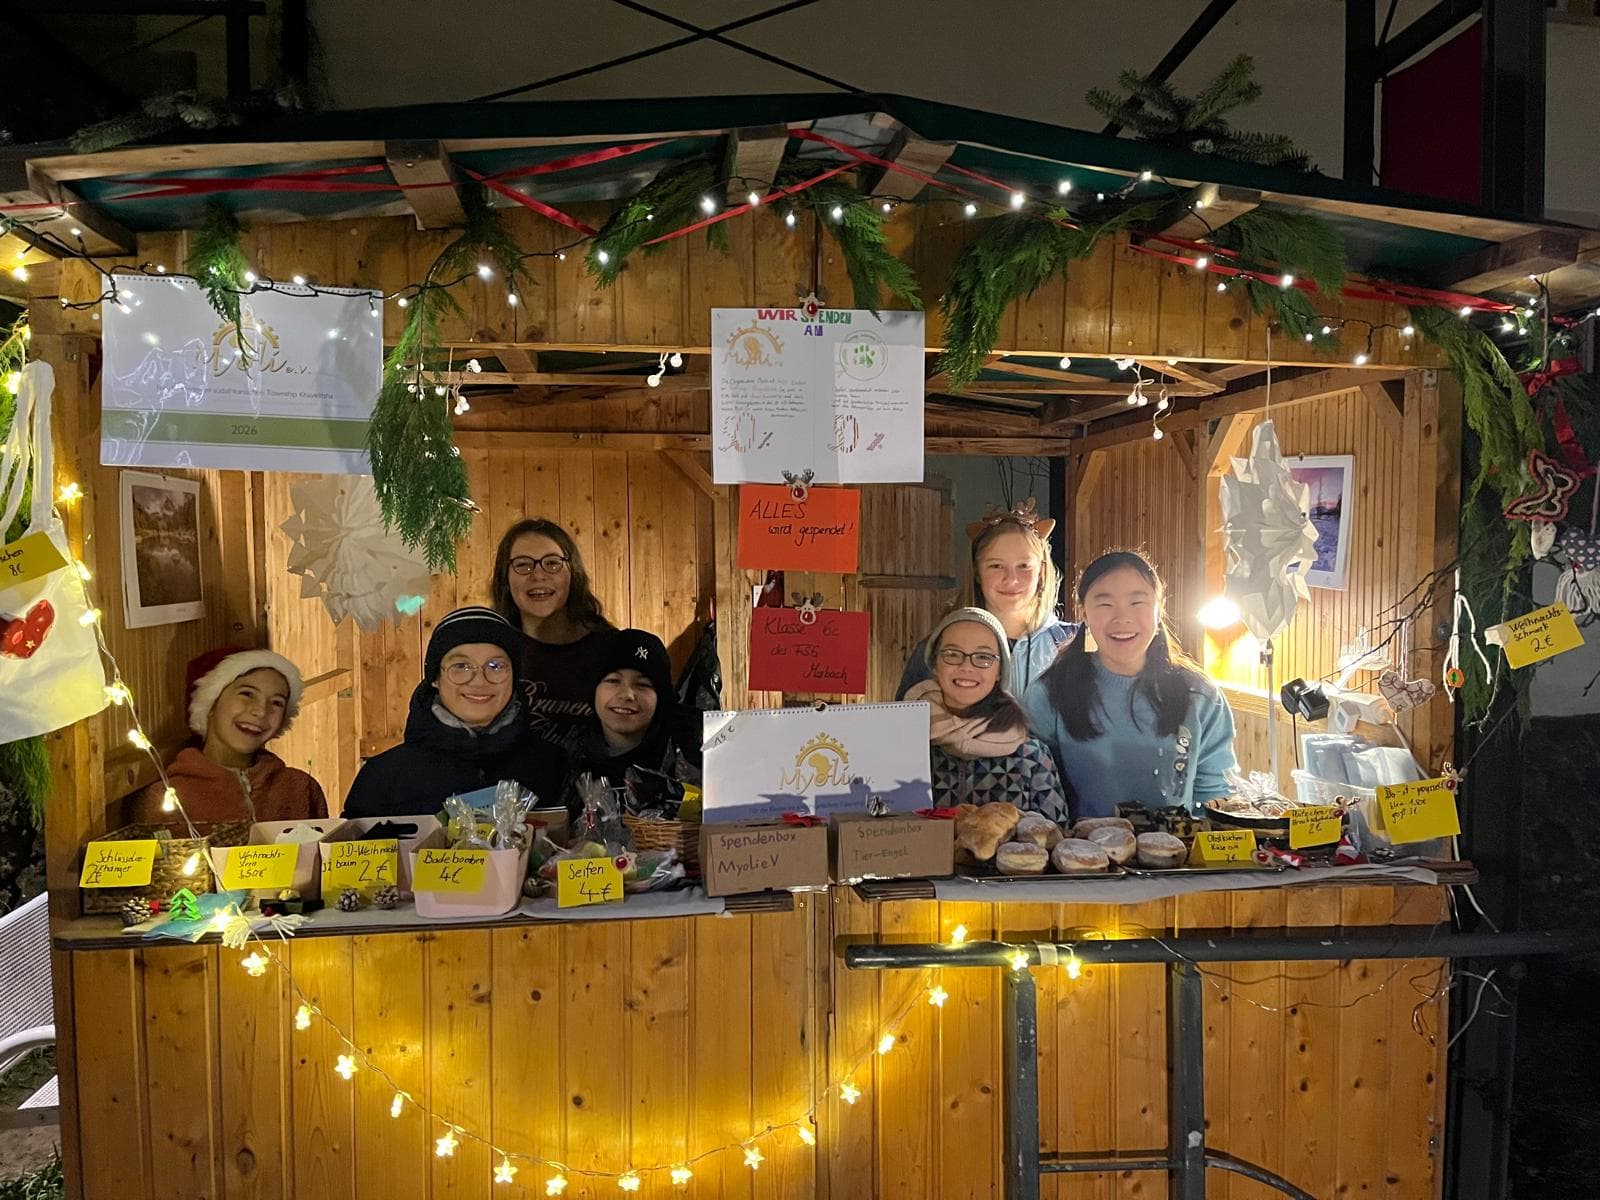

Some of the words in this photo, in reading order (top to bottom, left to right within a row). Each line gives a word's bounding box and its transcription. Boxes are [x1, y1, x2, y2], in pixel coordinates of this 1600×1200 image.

[757, 309, 798, 321] WIR
[800, 309, 851, 325] SENDEN
[231, 424, 258, 435] 2026
[749, 500, 807, 519] ALLES
[768, 524, 792, 535] wird
[795, 523, 854, 547] gespendet!
[765, 616, 807, 635] Klasse
[721, 831, 797, 851] Spendenbox
[336, 859, 357, 869] baum
[568, 861, 604, 880] Seifen
[440, 866, 464, 884] 4€
